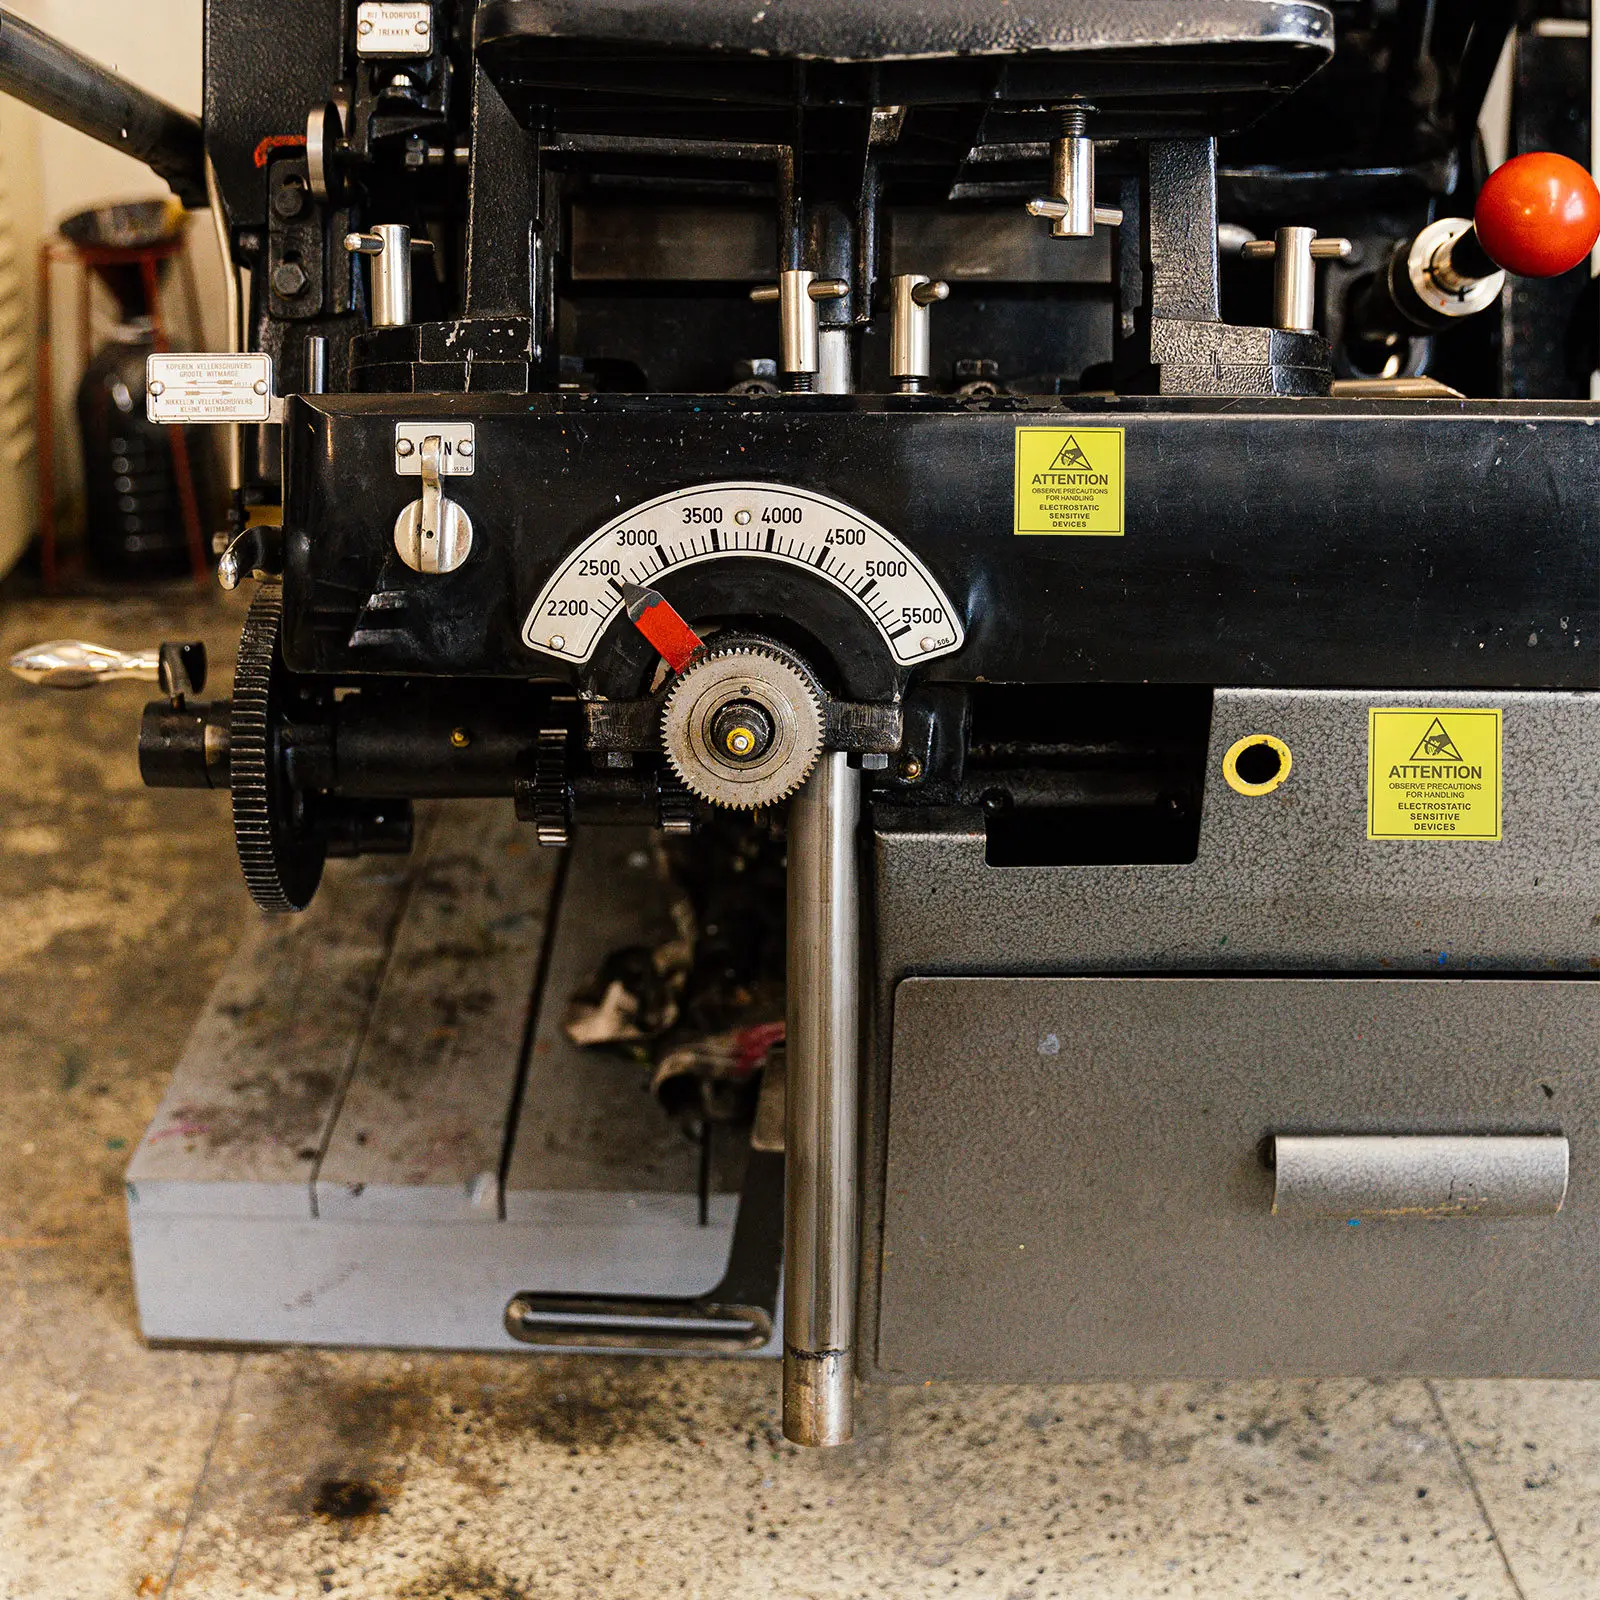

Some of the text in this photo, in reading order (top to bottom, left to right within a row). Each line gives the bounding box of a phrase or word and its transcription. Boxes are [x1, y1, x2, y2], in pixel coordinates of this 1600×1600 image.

[379, 28, 410, 36] TREKKEN
[1031, 474, 1109, 485] ATTENTION
[682, 507, 723, 524] 3500
[761, 507, 802, 524] 4000
[616, 529, 658, 546] 3000
[824, 529, 866, 546] 4500
[578, 560, 620, 576] 2500
[865, 561, 907, 577] 5000
[547, 600, 588, 616] 2200
[902, 607, 942, 624] 5500
[937, 637, 950, 646] 506
[1388, 765, 1482, 779] ATTENTION
[1398, 802, 1472, 810] ELECTROSTATIC
